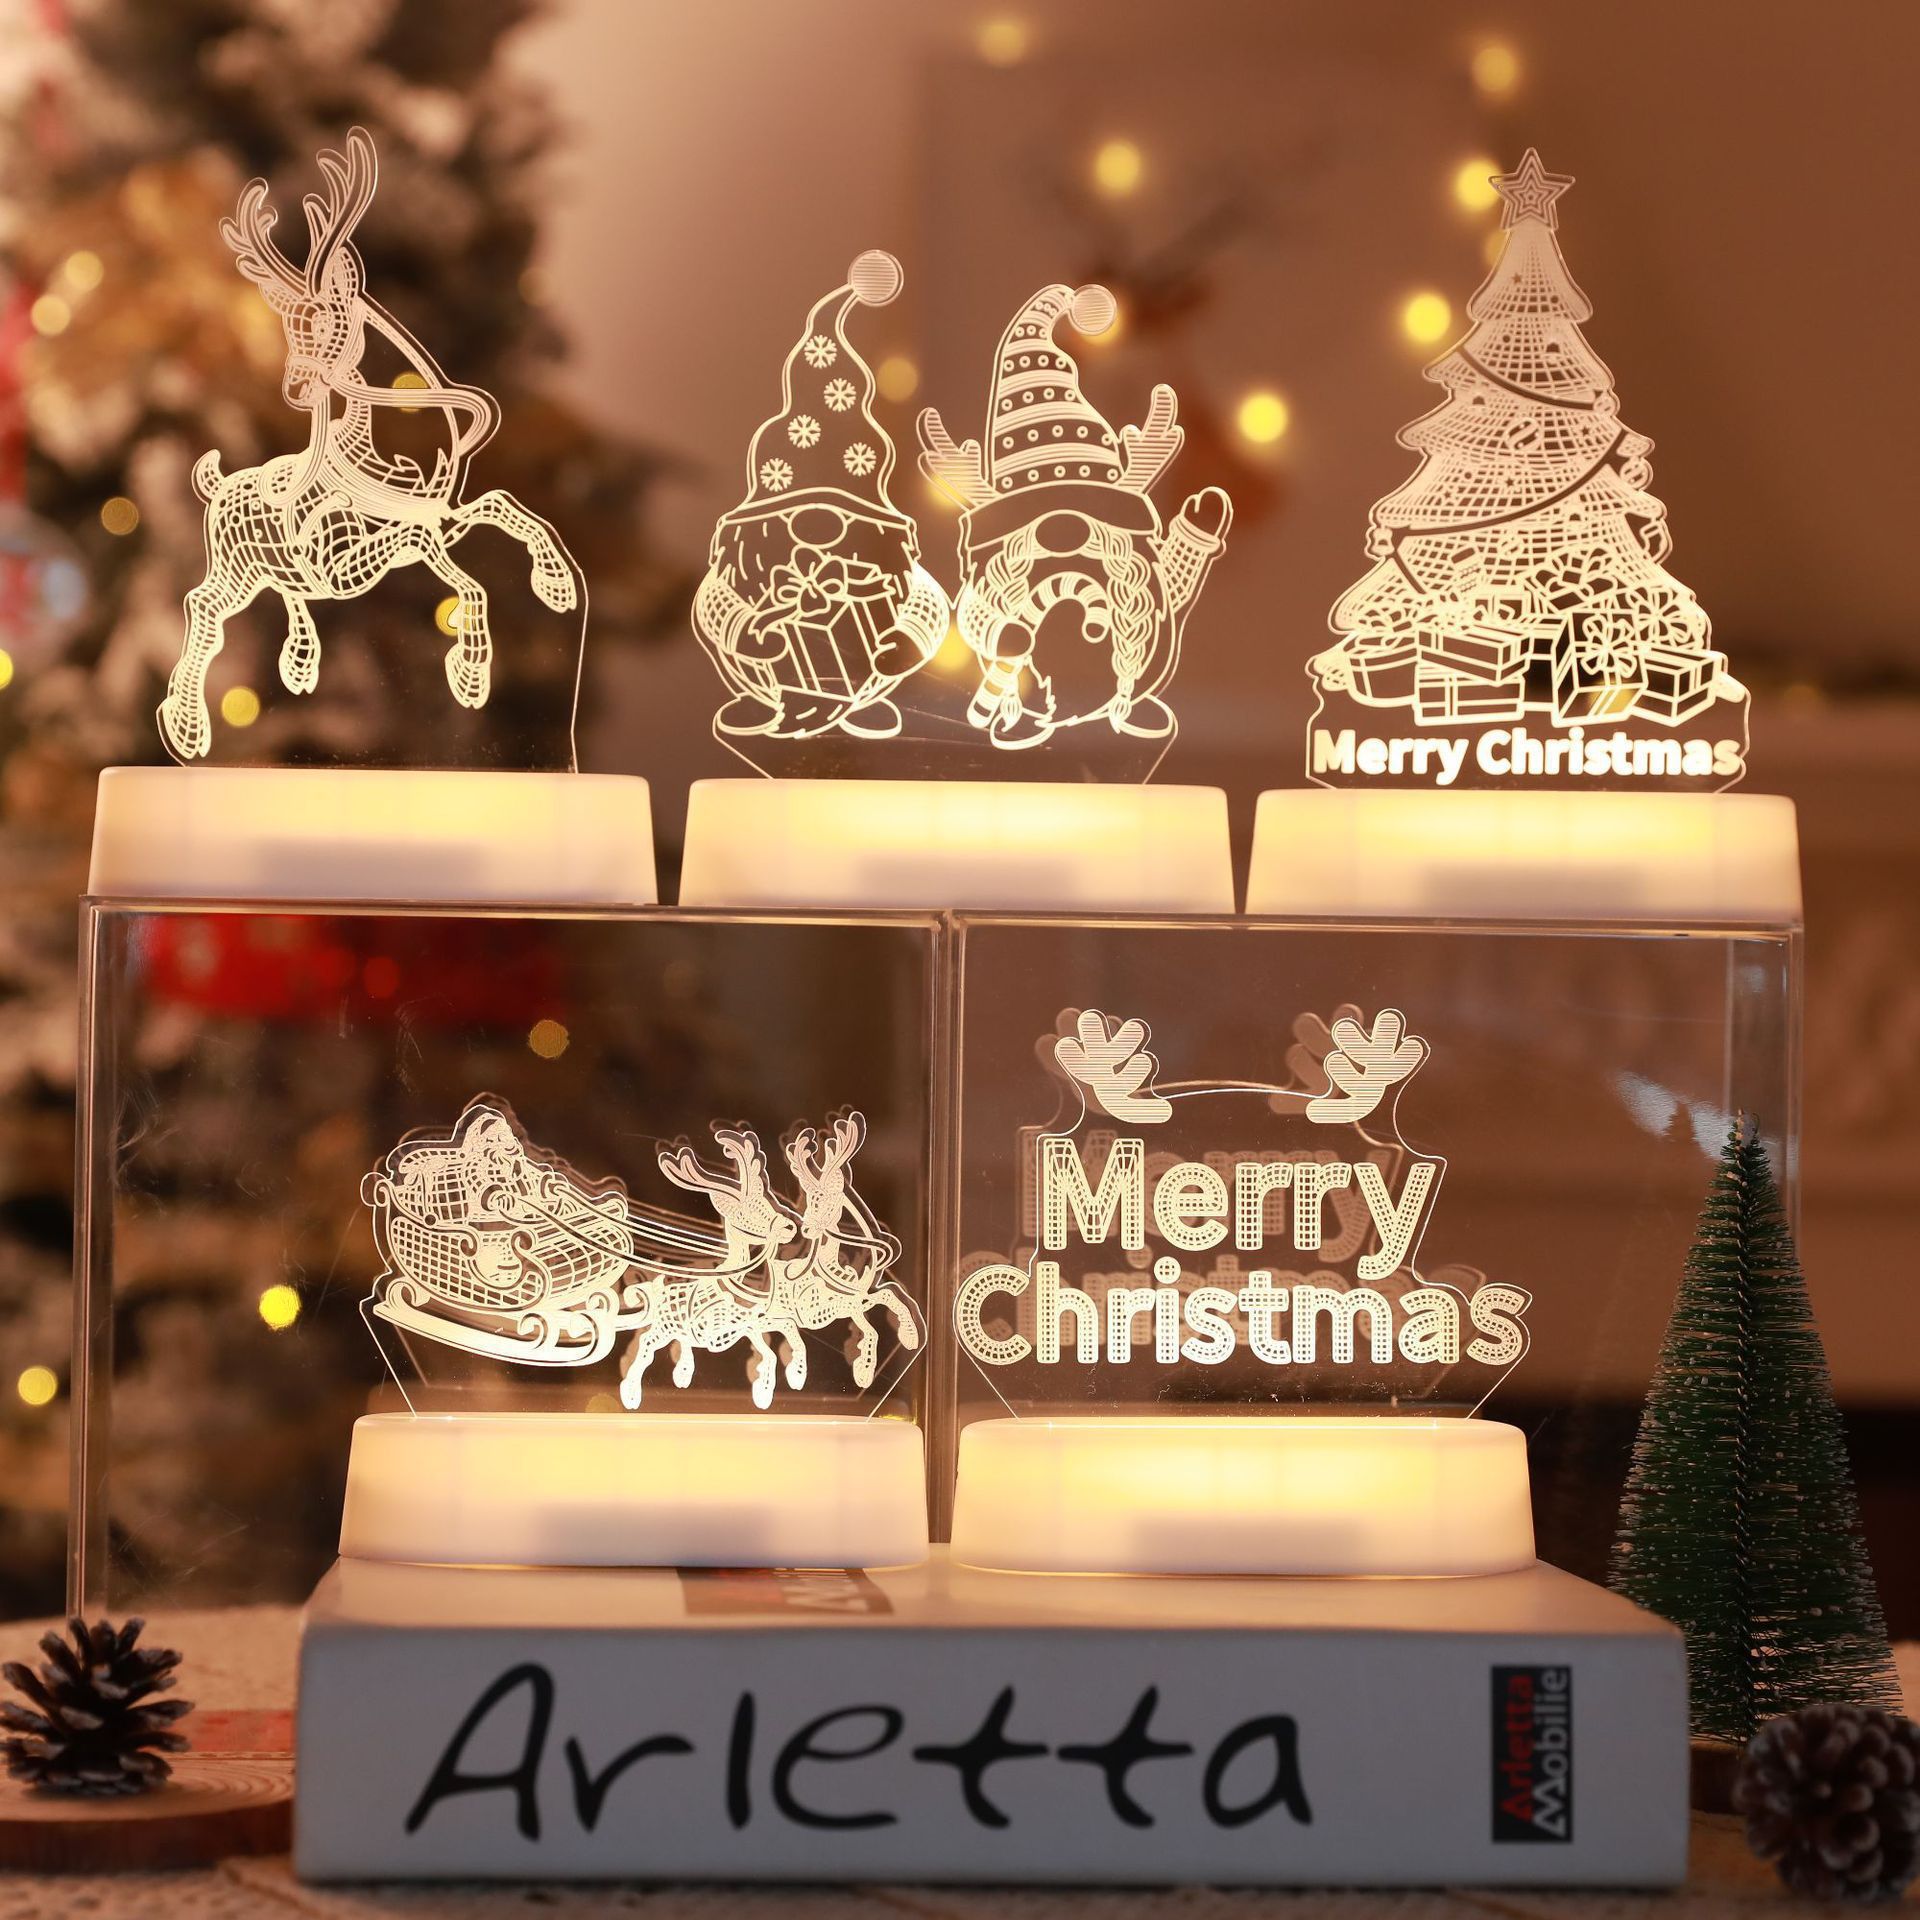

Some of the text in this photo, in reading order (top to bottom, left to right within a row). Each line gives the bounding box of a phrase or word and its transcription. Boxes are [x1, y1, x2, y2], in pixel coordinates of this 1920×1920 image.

[1313, 726, 1742, 785] Merry Christmas
[1042, 1137, 1437, 1281] Merry
[956, 1256, 1528, 1366] Christmas
[404, 1661, 1313, 1841] Arletta
[1501, 1674, 1534, 1824] Arletta
